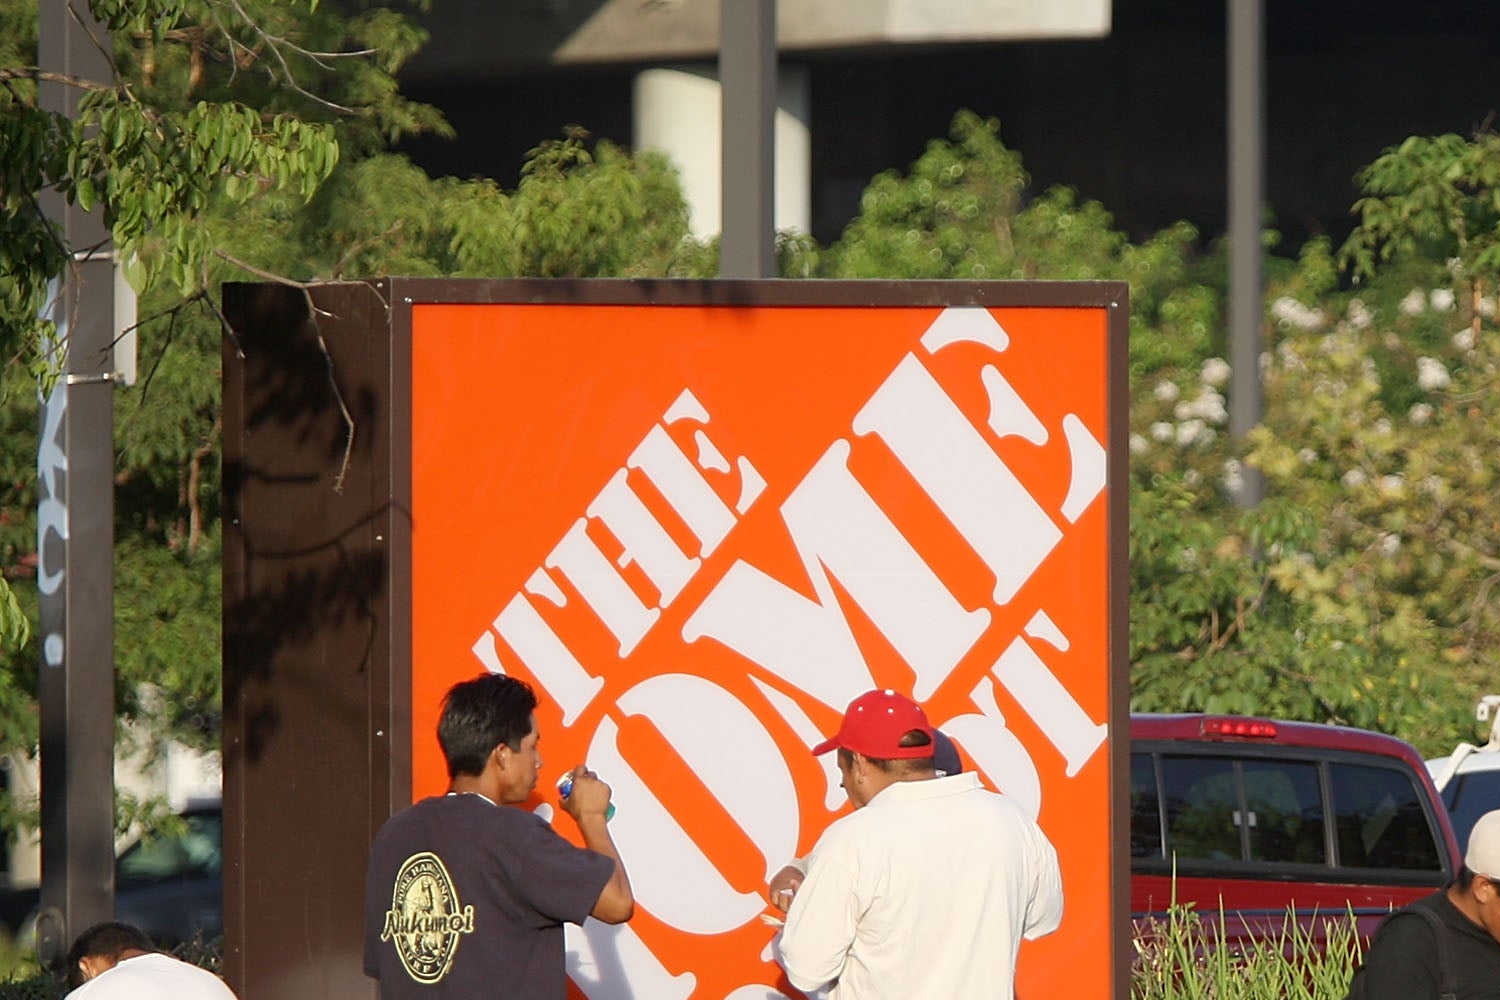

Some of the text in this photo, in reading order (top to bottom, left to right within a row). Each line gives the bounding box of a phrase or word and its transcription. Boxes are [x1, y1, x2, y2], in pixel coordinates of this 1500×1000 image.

[472, 387, 768, 728] THE
[397, 874, 413, 904] PURE
[380, 904, 475, 942] Nukumoi
[402, 941, 432, 973] SURF
